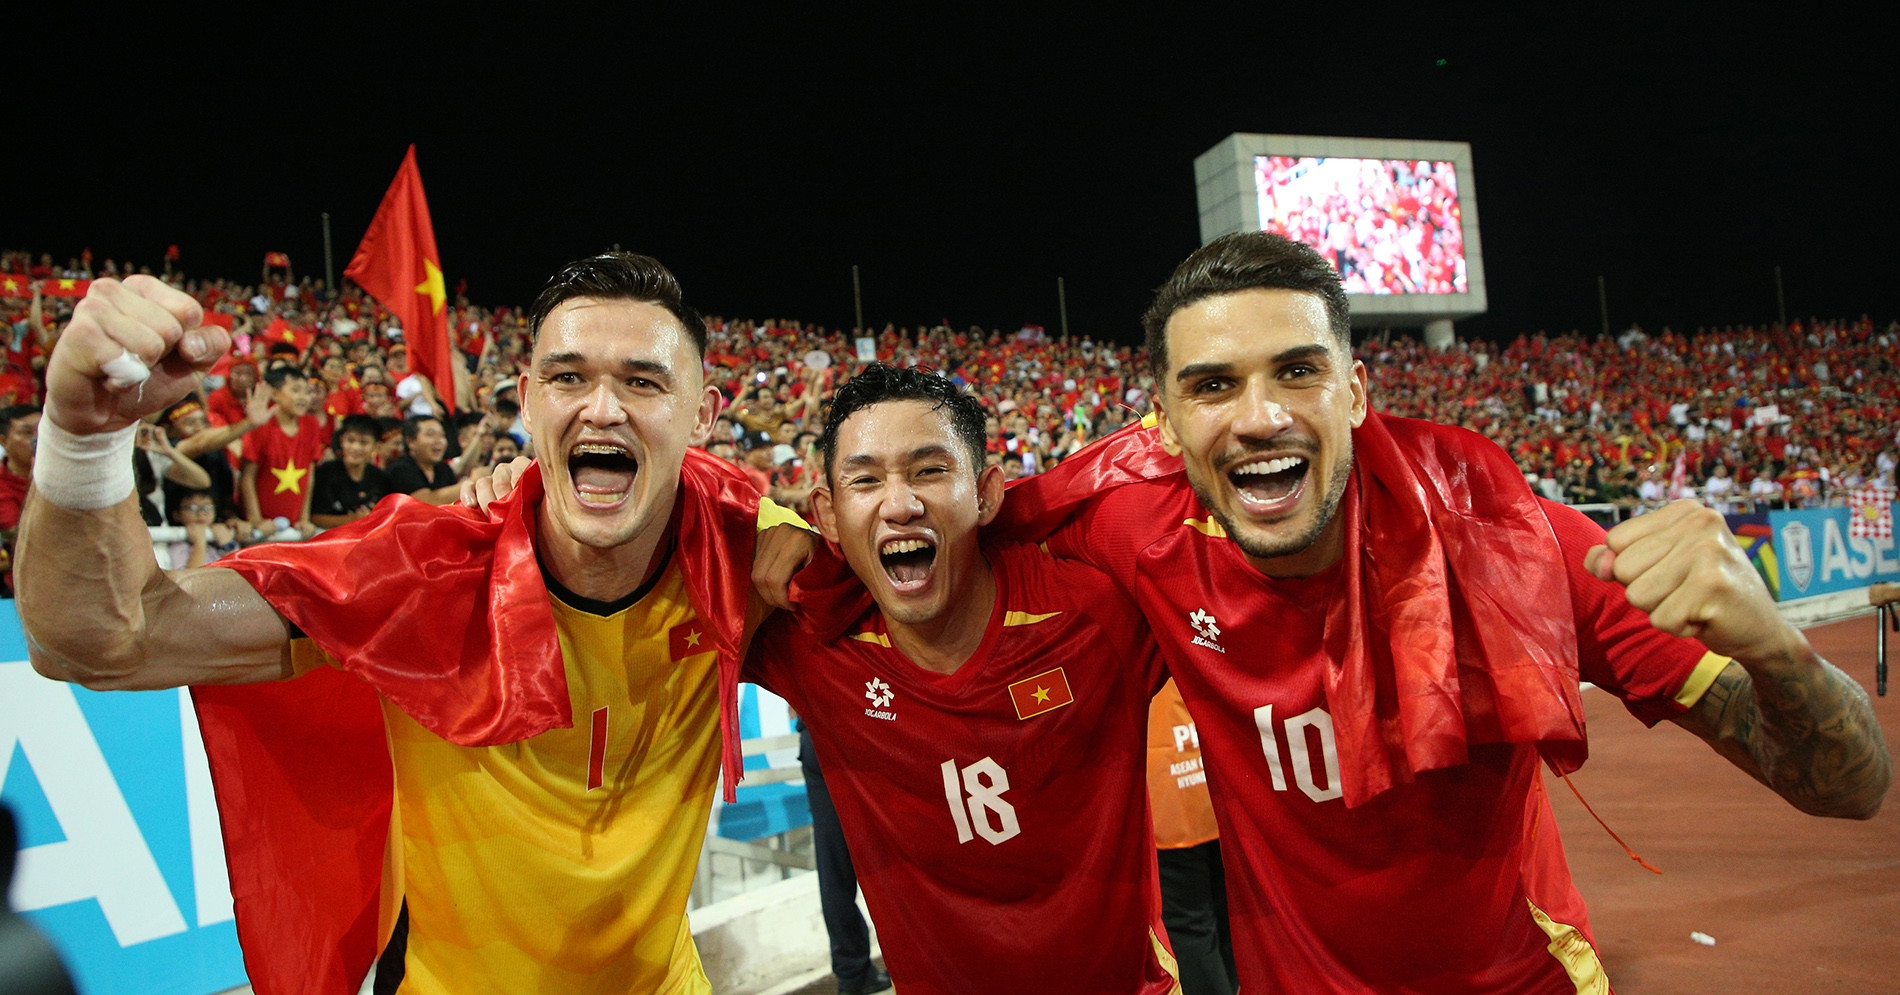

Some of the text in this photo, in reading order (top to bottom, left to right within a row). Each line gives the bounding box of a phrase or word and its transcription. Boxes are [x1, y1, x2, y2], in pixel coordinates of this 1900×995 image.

[586, 704, 609, 793] 1
[864, 708, 897, 721] JOGARBOLA
[1253, 703, 1344, 803] 10
[940, 756, 1021, 846] 18
[1170, 758, 1199, 776] ASEAN
